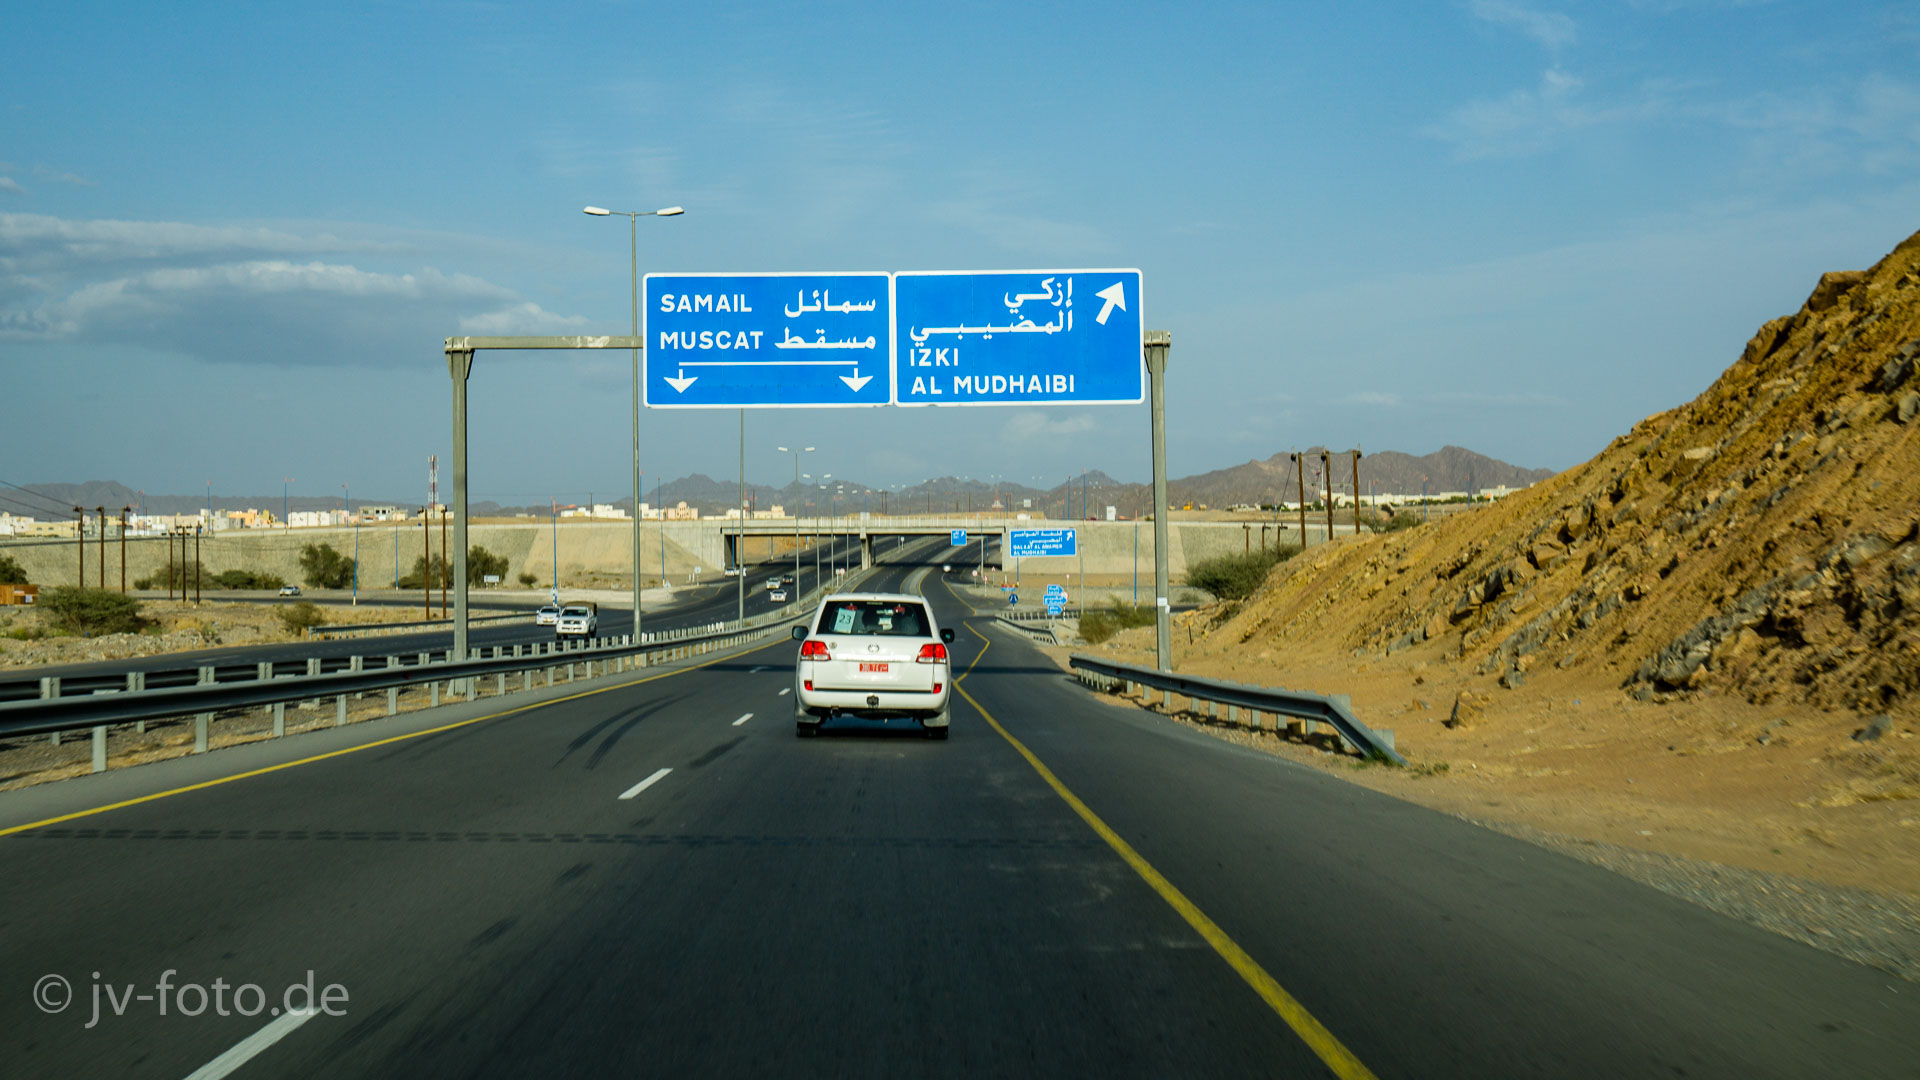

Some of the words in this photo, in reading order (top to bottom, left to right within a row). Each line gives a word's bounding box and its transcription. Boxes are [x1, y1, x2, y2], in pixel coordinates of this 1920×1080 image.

[660, 294, 752, 313] SAMAIL
[784, 289, 877, 318] سمائل
[1004, 276, 1073, 314] إزكي
[660, 331, 764, 350] MUSCAT
[774, 326, 877, 350] مسقط
[910, 347, 959, 367] IZKI
[911, 376, 942, 395] AL
[953, 374, 1075, 394] MUDHAIBI
[838, 614, 852, 624] 23
